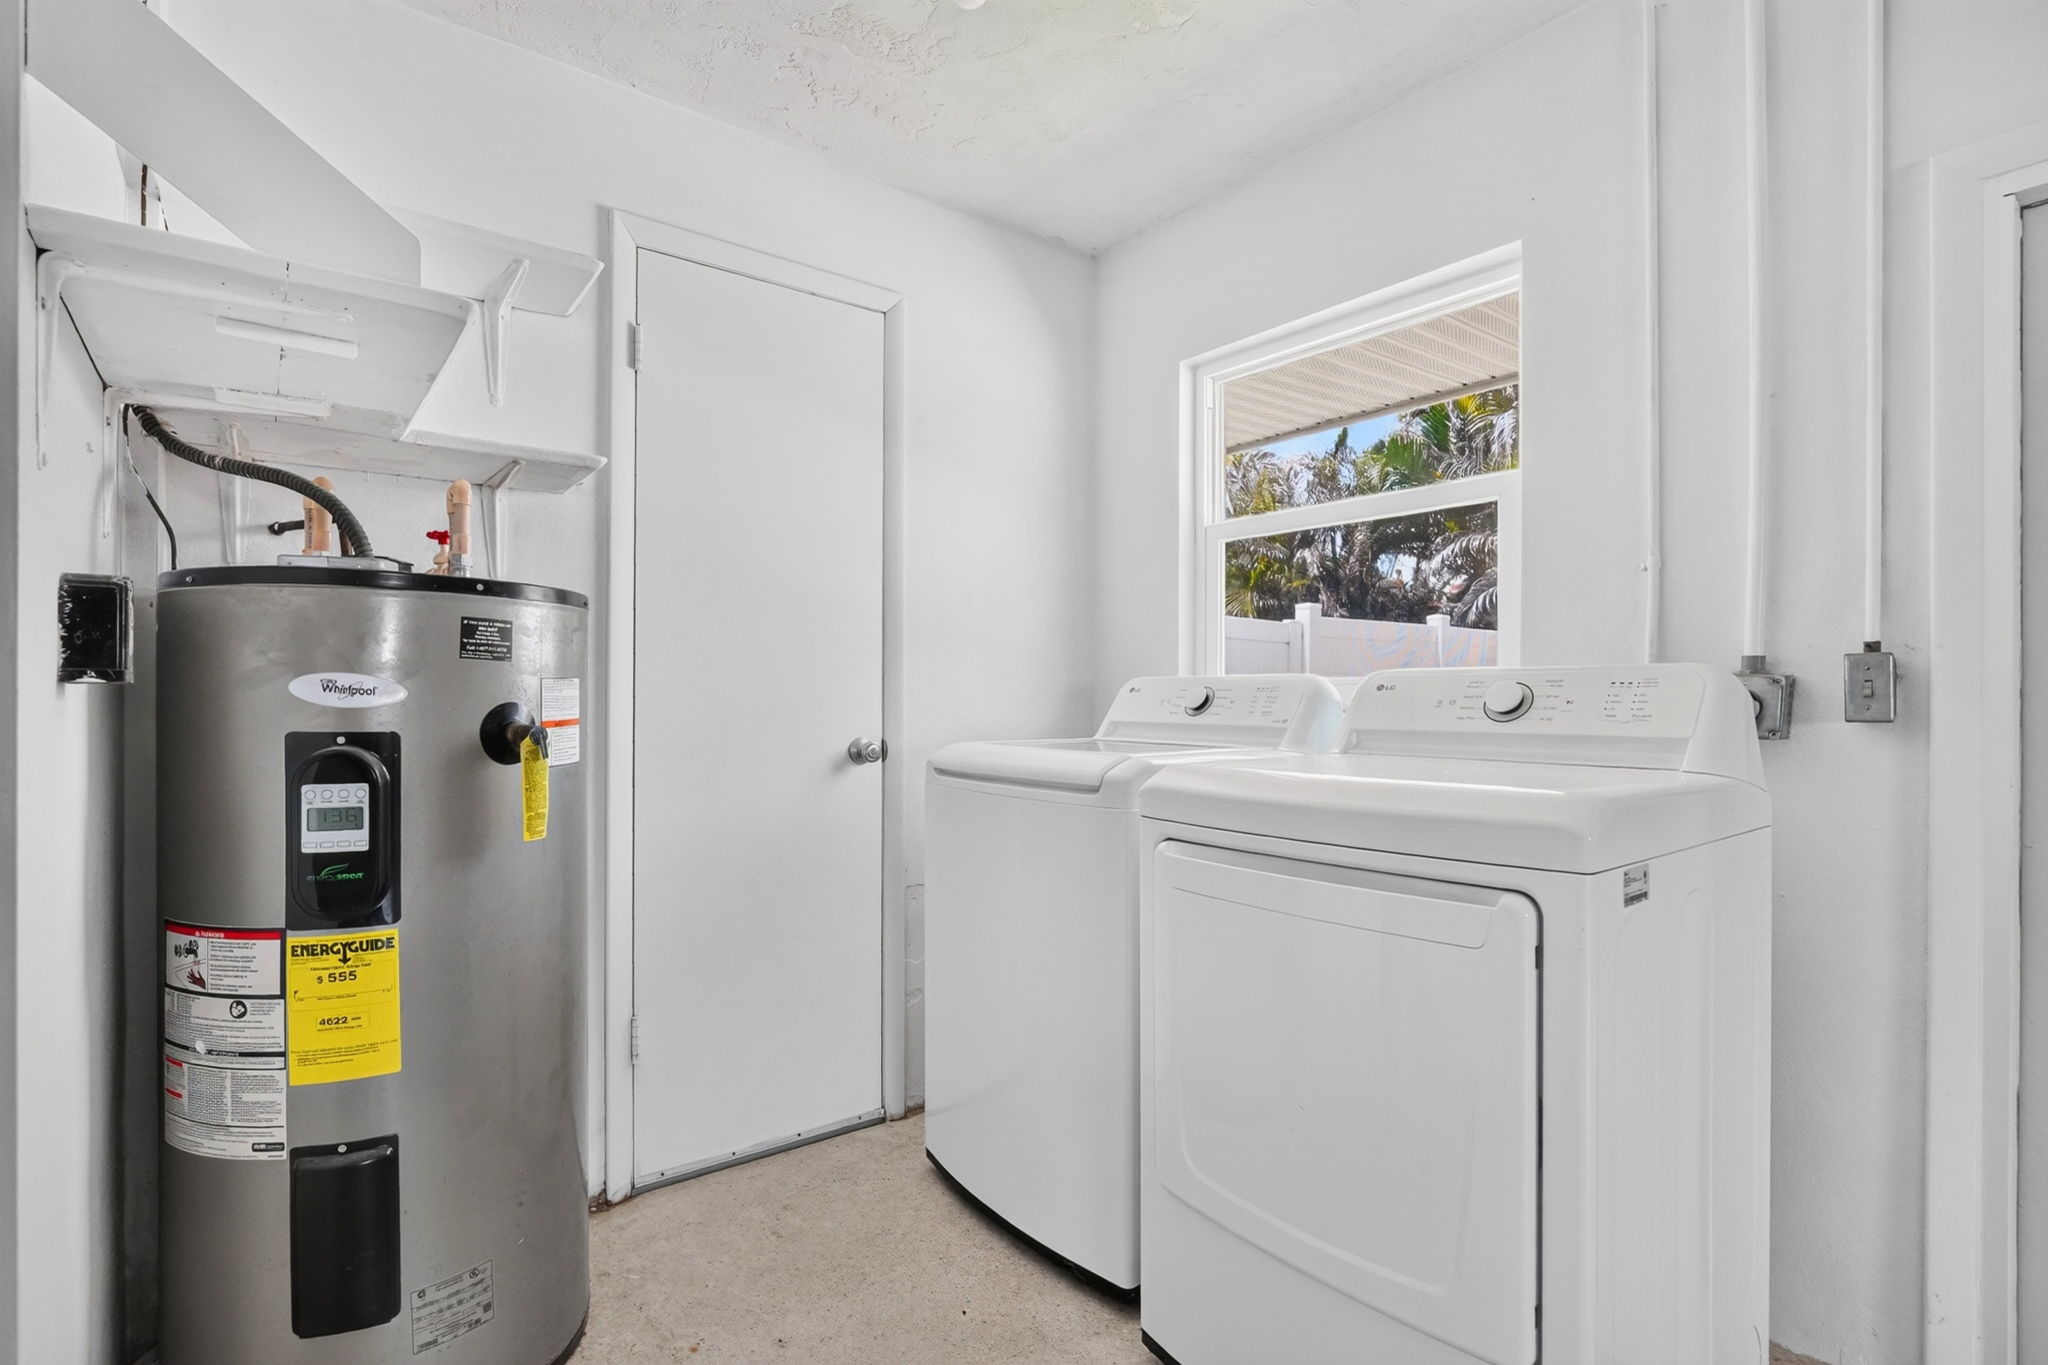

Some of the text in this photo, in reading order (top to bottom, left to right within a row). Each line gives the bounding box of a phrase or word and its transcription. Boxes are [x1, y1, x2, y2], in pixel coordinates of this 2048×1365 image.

[320, 679, 377, 697] Whirlpool
[324, 808, 357, 823] 136
[291, 937, 396, 960] ENERGYGUIDE
[328, 970, 358, 983] 555
[319, 1016, 348, 1026] 4622
